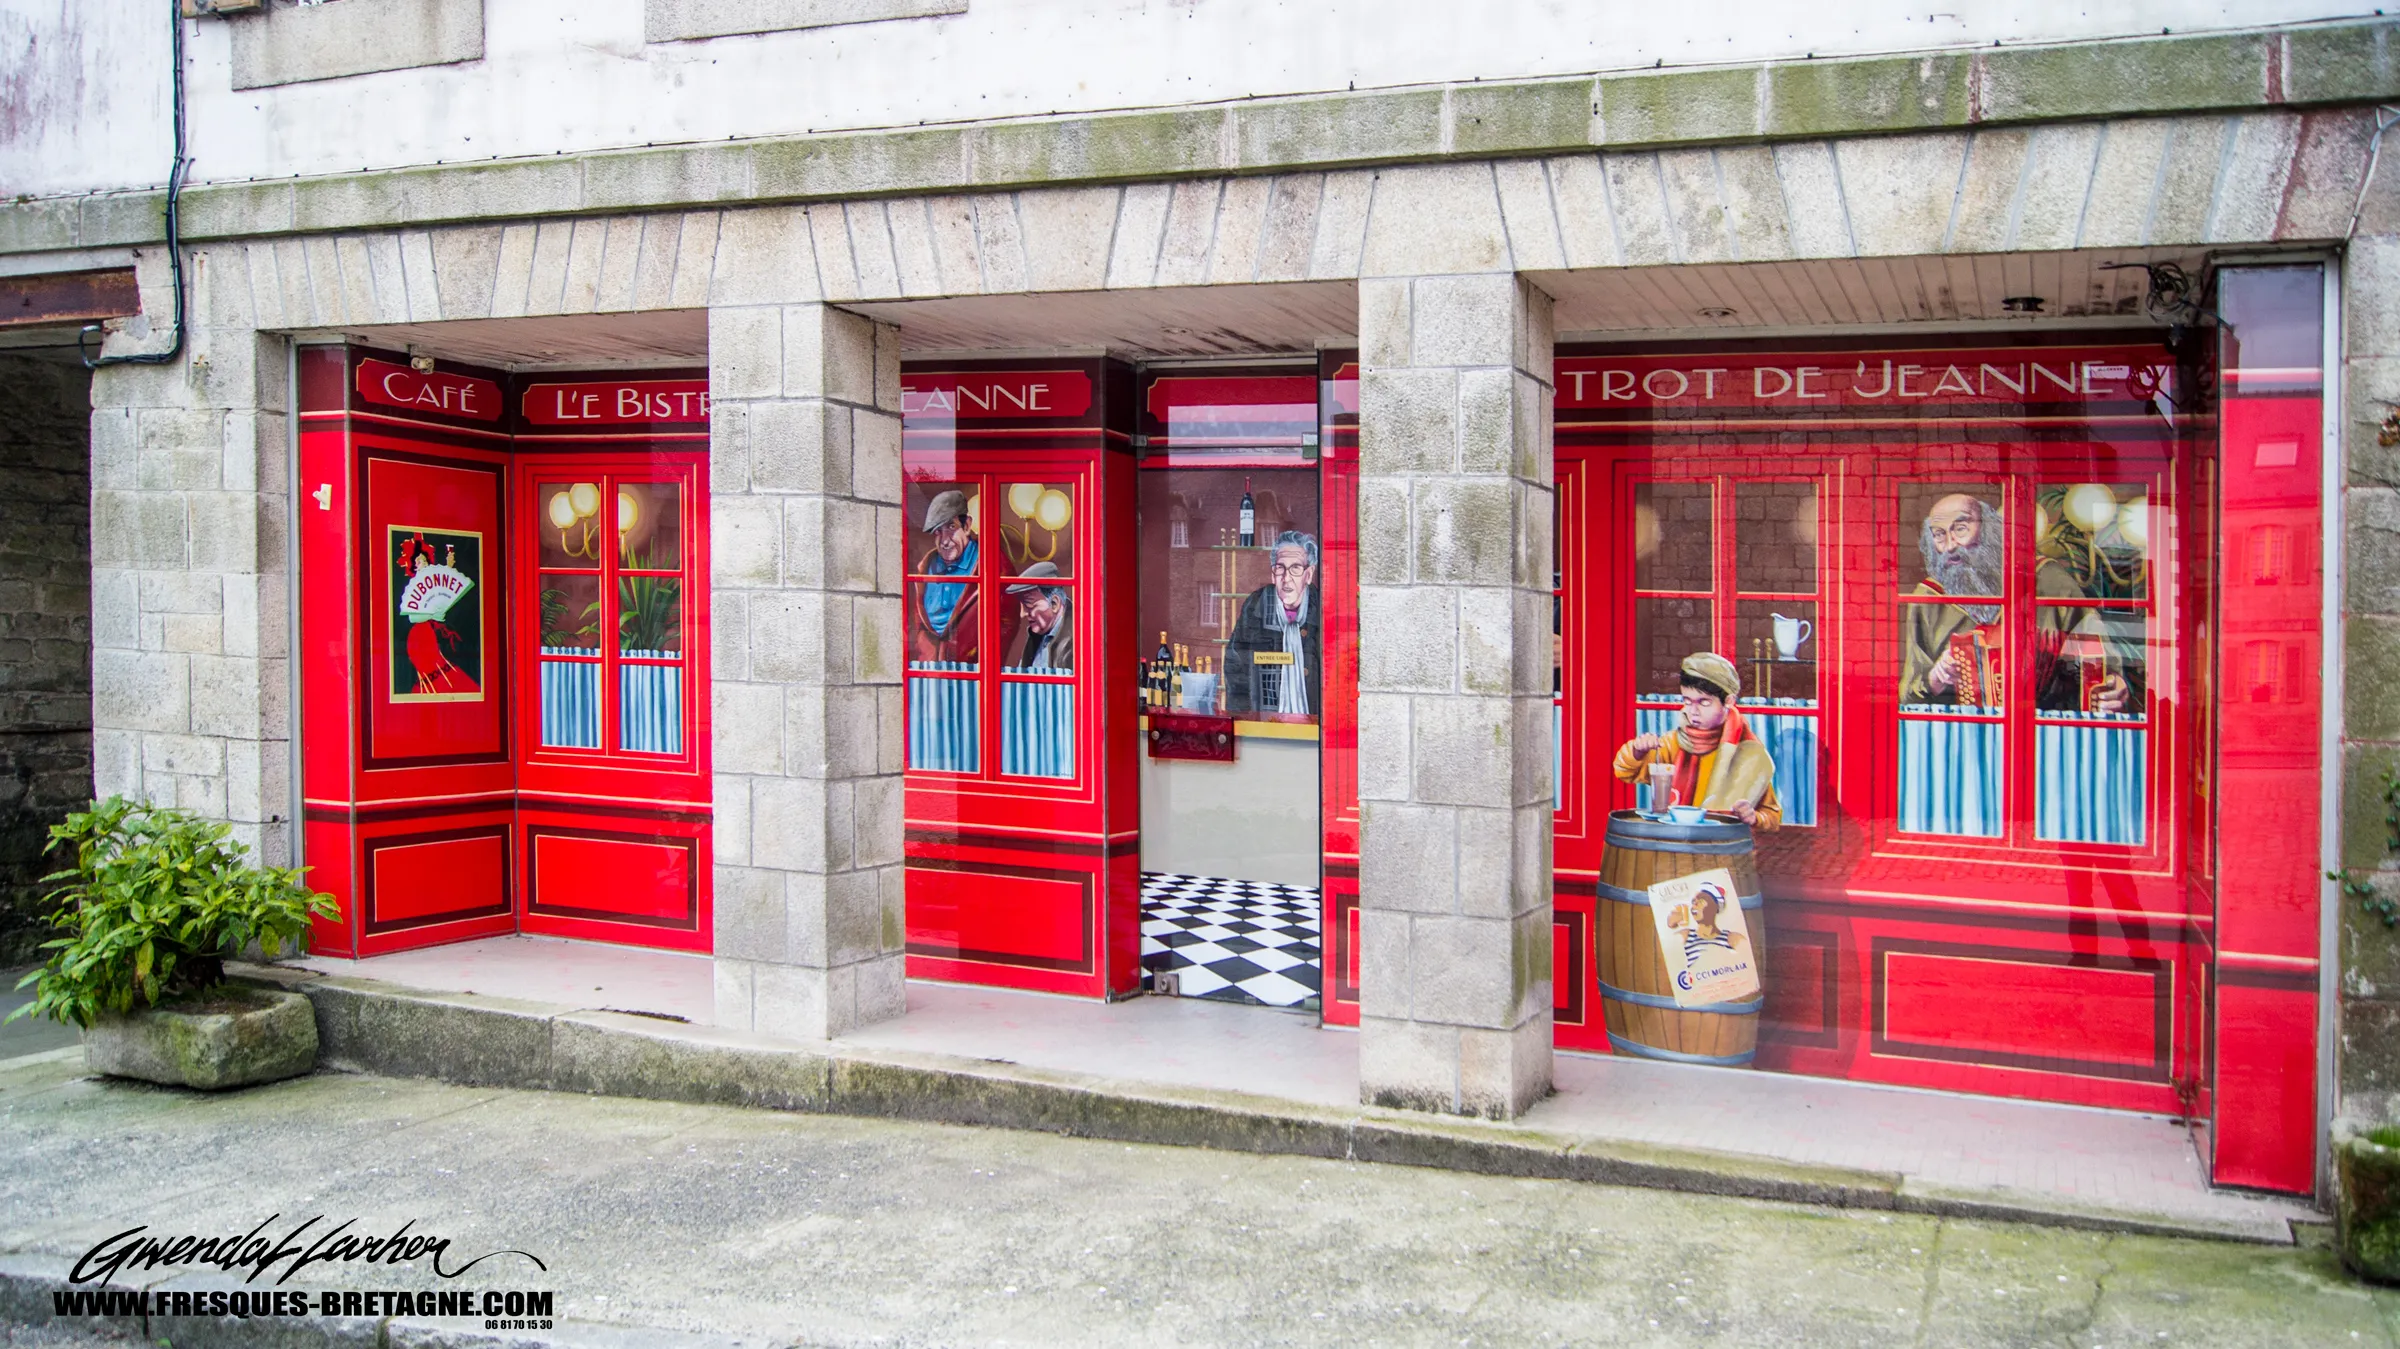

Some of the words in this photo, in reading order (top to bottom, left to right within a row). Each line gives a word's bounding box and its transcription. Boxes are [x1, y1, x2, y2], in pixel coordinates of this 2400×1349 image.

[383, 372, 478, 414] CAFÉ
[1561, 368, 1727, 401] TROT
[1753, 366, 1826, 399] DE
[407, 573, 463, 610] DUBONNET
